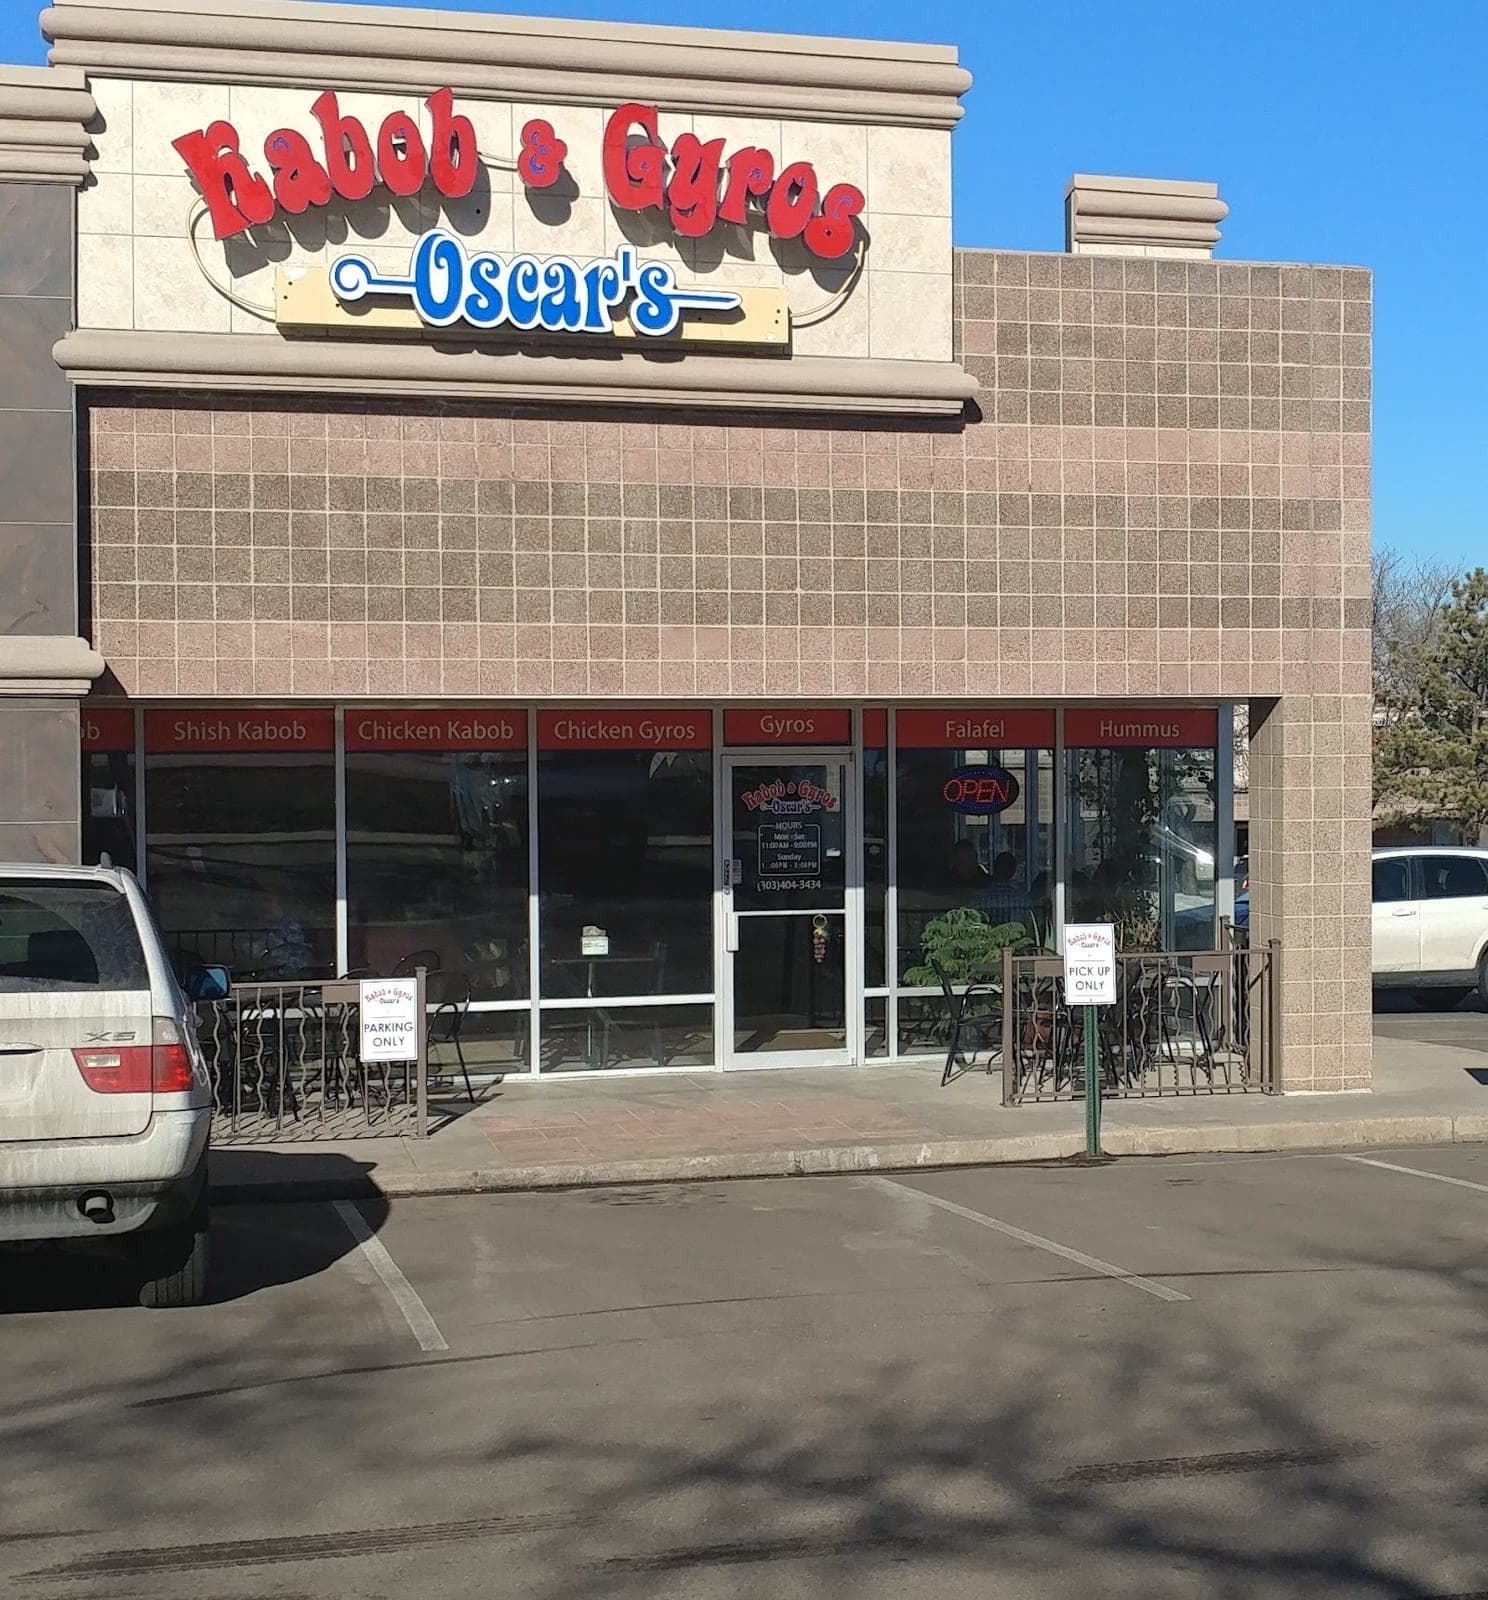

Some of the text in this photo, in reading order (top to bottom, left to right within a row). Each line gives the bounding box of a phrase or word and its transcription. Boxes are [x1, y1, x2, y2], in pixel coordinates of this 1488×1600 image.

[172, 86, 866, 259] Kabob & Gyros
[411, 228, 679, 336] Oscar's
[173, 721, 307, 741] Shish Kabob
[358, 720, 514, 741] Chicken Kabob
[553, 720, 696, 744] Chicken Gyros
[760, 715, 815, 735] Gyros
[945, 720, 1006, 739] Falafel
[1099, 720, 1181, 739] Hummus
[943, 779, 1012, 804] OPEN
[775, 821, 803, 830] HOURS
[777, 852, 802, 862] Sunday
[1069, 966, 1110, 976] PICK UP
[1075, 981, 1104, 990] ONLY
[82, 1031, 136, 1042] X5
[364, 1022, 413, 1033] PARKING
[372, 1037, 405, 1047] ONLY
